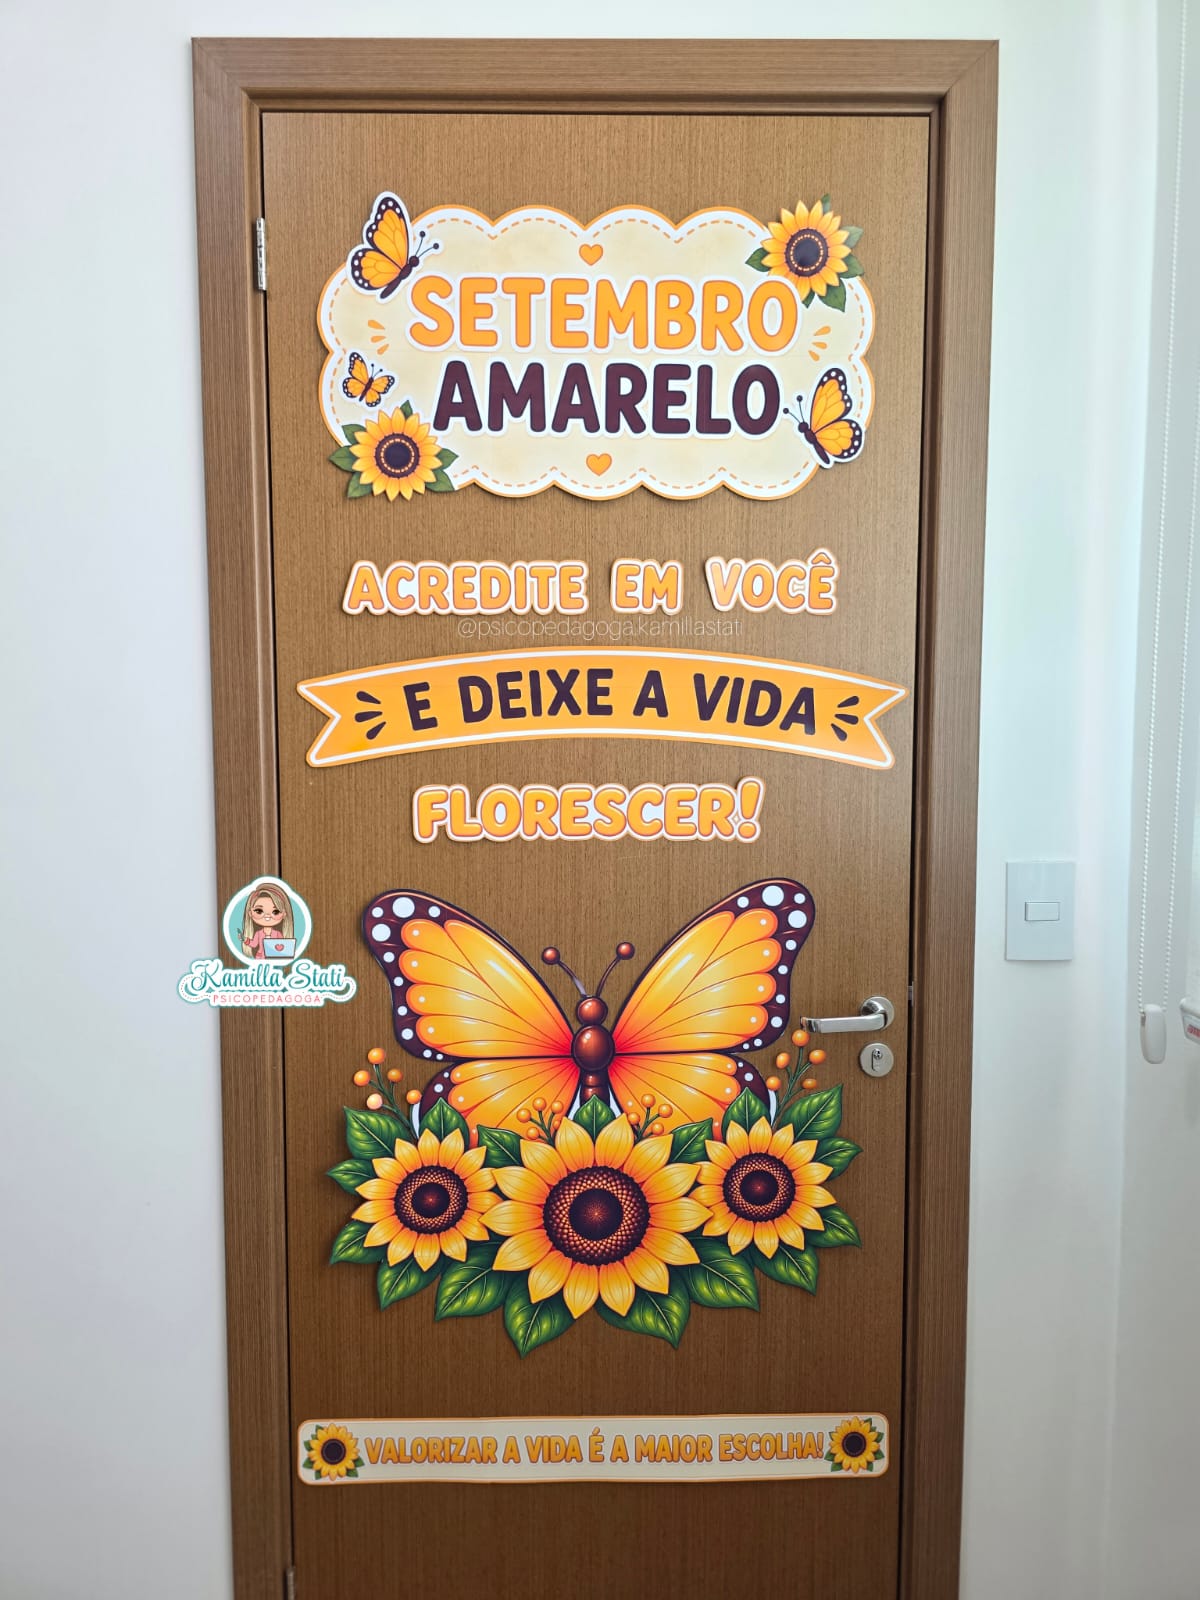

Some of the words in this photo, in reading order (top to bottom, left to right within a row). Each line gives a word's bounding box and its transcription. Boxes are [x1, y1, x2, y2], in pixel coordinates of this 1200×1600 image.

[408, 275, 798, 351] SETEMBRO
[433, 361, 780, 434] AMARELO
[347, 564, 585, 610] ACREDITE
[616, 564, 679, 609] EM
[710, 551, 836, 609] VOCÊ
[403, 681, 437, 731] E
[458, 668, 614, 724] DEIXE
[633, 670, 668, 718] A
[693, 672, 816, 735] VIDA
[415, 779, 760, 840] FLORESCER!
[365, 1436, 497, 1464] VALORIZAR
[502, 1436, 520, 1463] A
[525, 1435, 581, 1463] VIDA
[588, 1427, 604, 1462] É
[609, 1435, 629, 1462] A
[634, 1433, 713, 1462] MAIOR
[718, 1432, 824, 1461] ESCOLHA!
